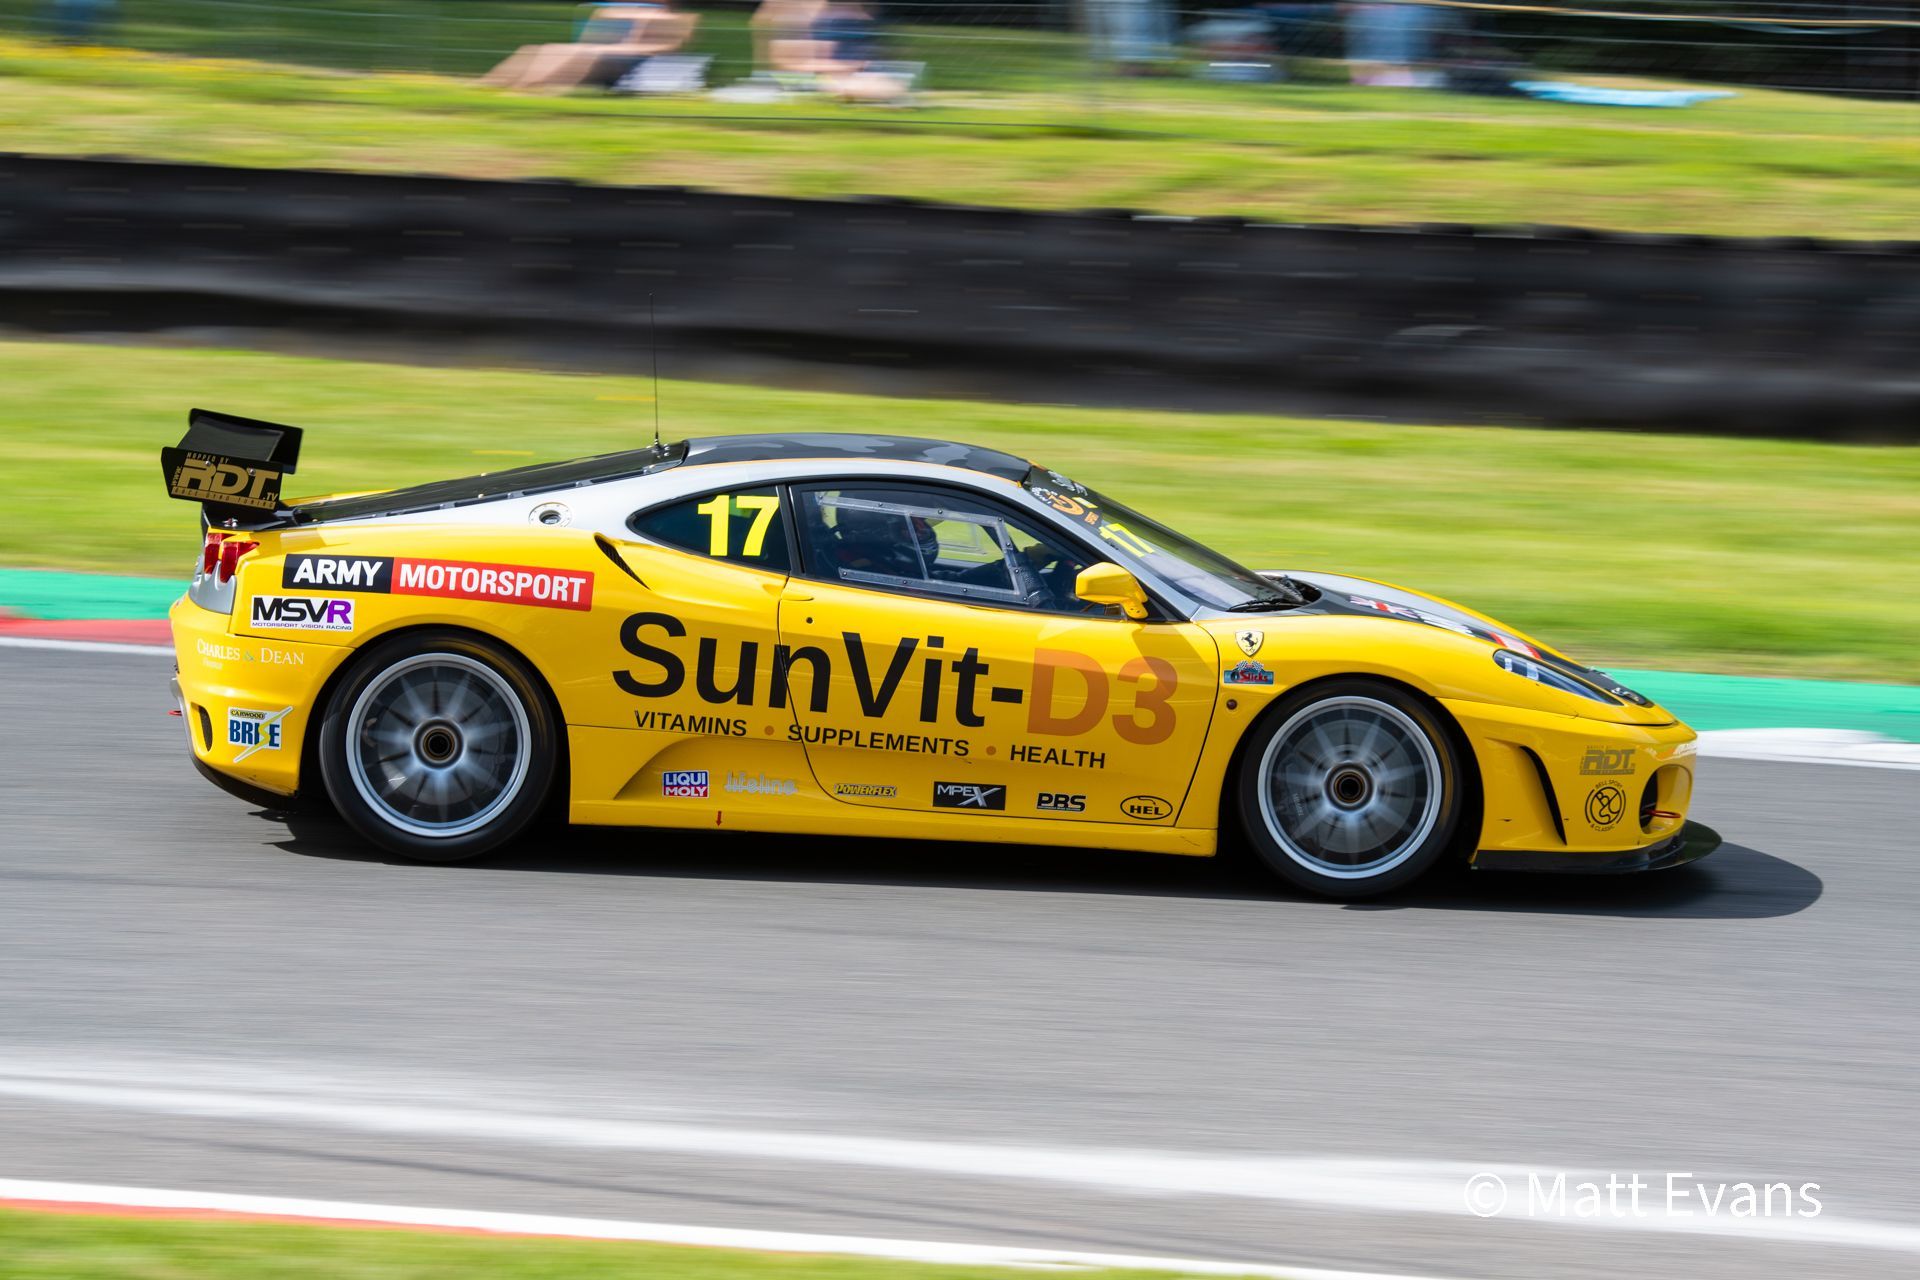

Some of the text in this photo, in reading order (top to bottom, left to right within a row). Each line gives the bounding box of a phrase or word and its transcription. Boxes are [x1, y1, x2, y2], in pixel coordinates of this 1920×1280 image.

[177, 458, 279, 499] RDT
[697, 494, 780, 557] 17
[1099, 522, 1155, 558] 17
[293, 558, 587, 603] ARMY MOTORSPORT
[252, 597, 352, 625] MSVR
[197, 637, 240, 661] CHARLES
[260, 647, 305, 665] DEAN
[612, 611, 1178, 746] SunVit-D3
[634, 710, 1106, 769] VITAMINS SUPPLEMENTS HEALTH
[665, 772, 707, 786] LIQUI
[665, 785, 708, 797] MOLY
[937, 784, 1002, 808] MPEX
[1037, 793, 1086, 812] PRS
[1129, 804, 1163, 816] HEL
